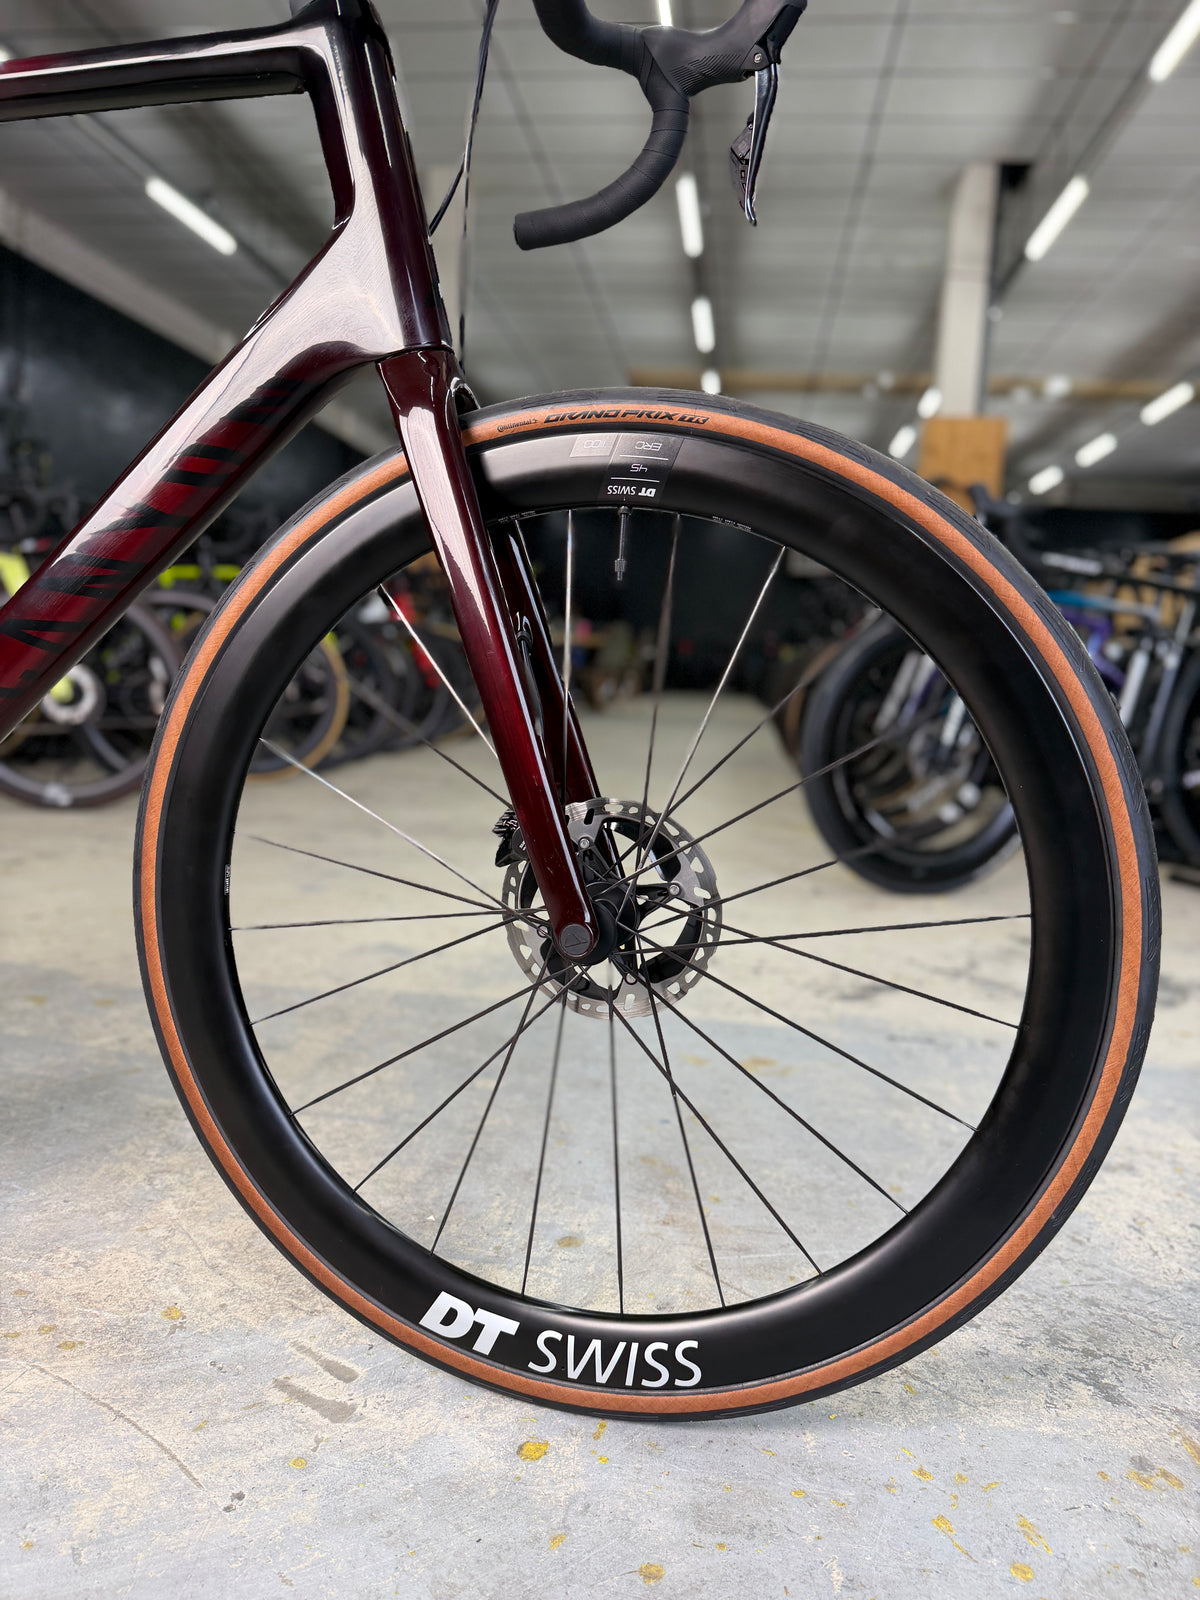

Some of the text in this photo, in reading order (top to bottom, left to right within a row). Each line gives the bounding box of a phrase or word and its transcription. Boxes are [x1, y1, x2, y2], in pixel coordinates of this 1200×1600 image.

[544, 410, 622, 423] GRAND
[621, 409, 679, 421] PRIX
[635, 440, 663, 452] ERC
[630, 463, 648, 473] 45
[607, 485, 656, 498] DT SWISS
[418, 1290, 702, 1388] DT SWISS
